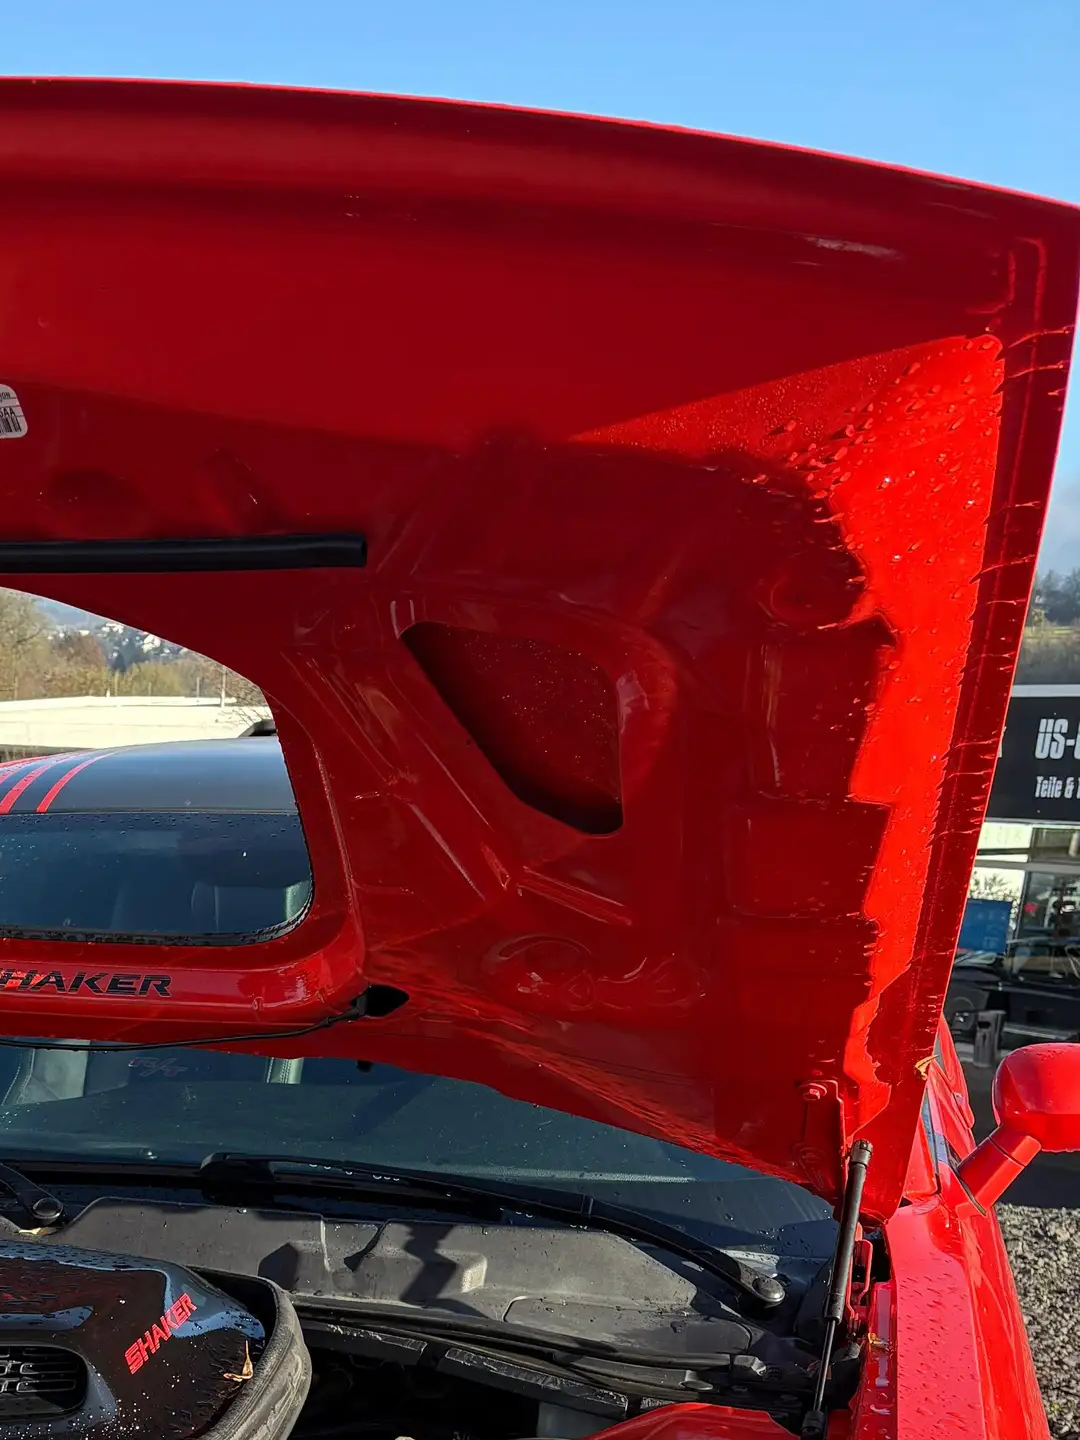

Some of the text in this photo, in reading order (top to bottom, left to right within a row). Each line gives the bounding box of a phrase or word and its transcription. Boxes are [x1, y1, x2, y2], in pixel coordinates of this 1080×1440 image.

[1035, 775, 1075, 799] Teile &
[124, 1292, 198, 1375] SHAKER
